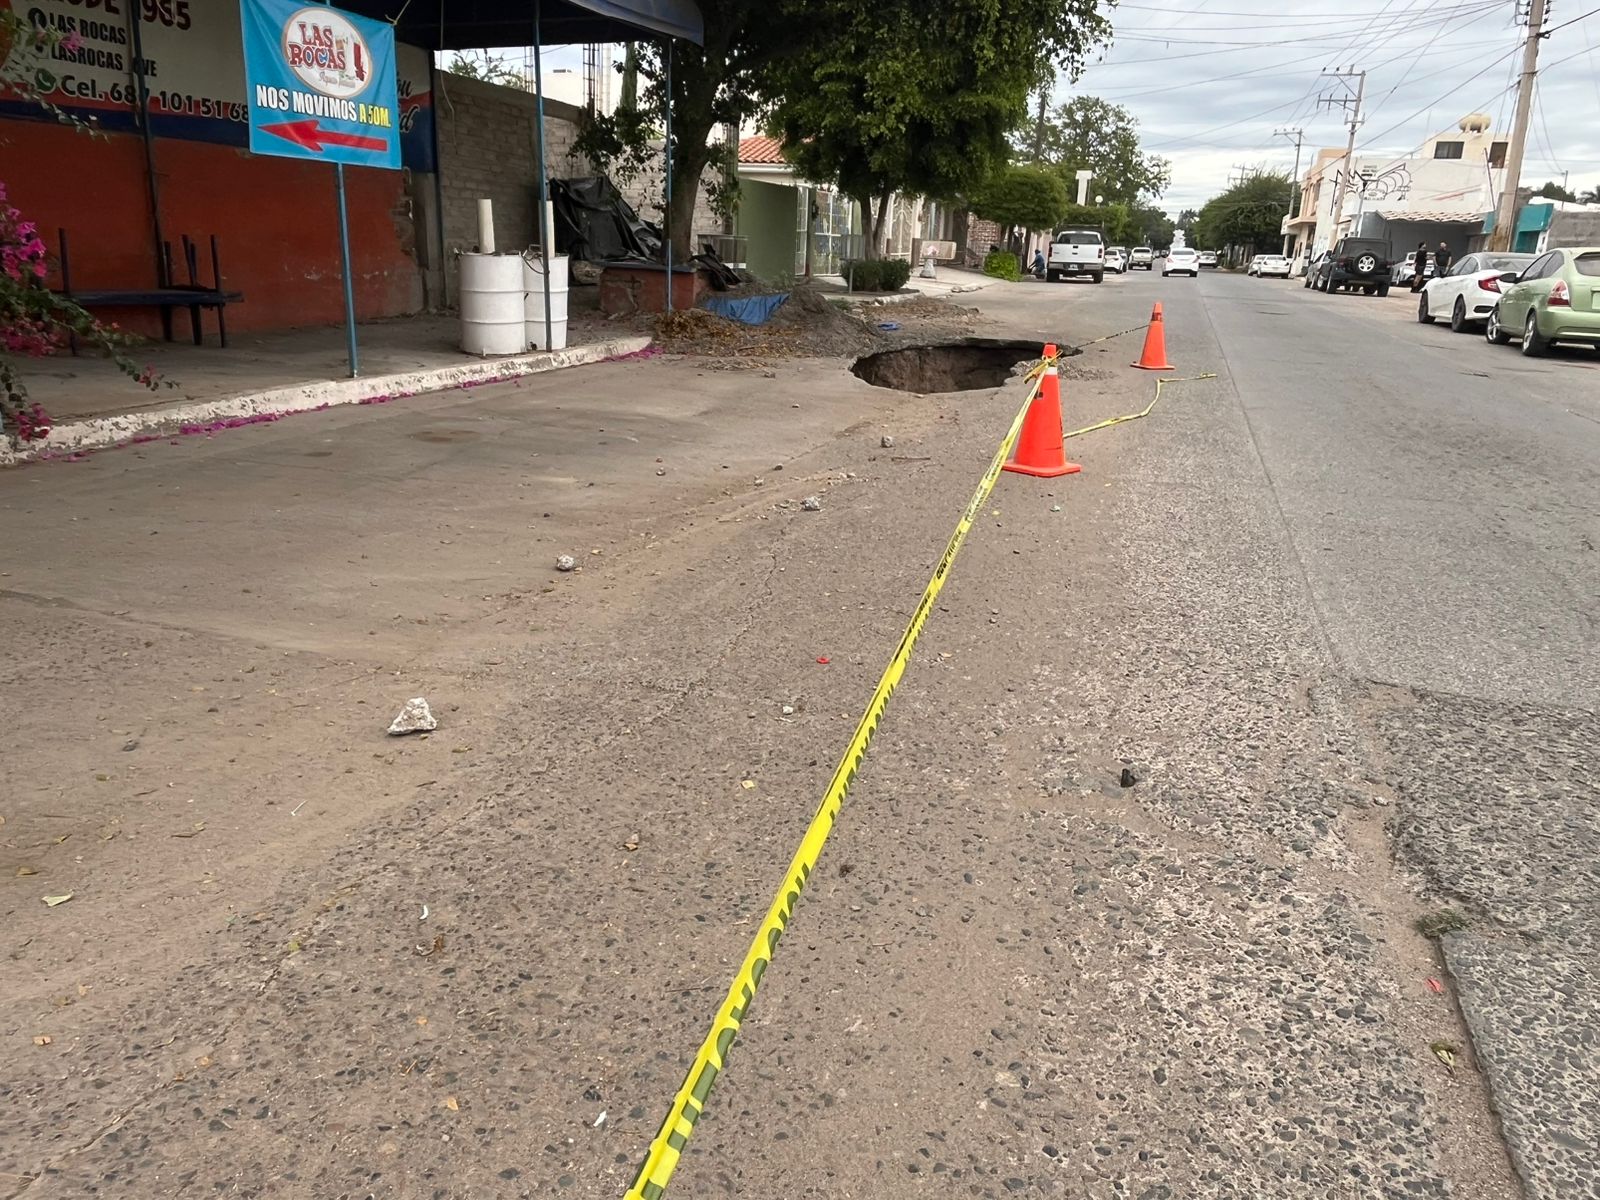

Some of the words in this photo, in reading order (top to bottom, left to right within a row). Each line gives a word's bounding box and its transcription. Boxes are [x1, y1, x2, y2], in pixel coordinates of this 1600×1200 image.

[50, 13, 77, 33] LAS
[80, 19, 127, 45] ROCAS
[297, 21, 333, 48] LAS
[287, 42, 347, 70] ROCAS
[61, 75, 104, 100] Cel.
[159, 91, 194, 113] 101
[199, 98, 222, 118] 51
[256, 85, 289, 111] NOS
[292, 91, 357, 122] MOVIMOS
[359, 104, 367, 123] A
